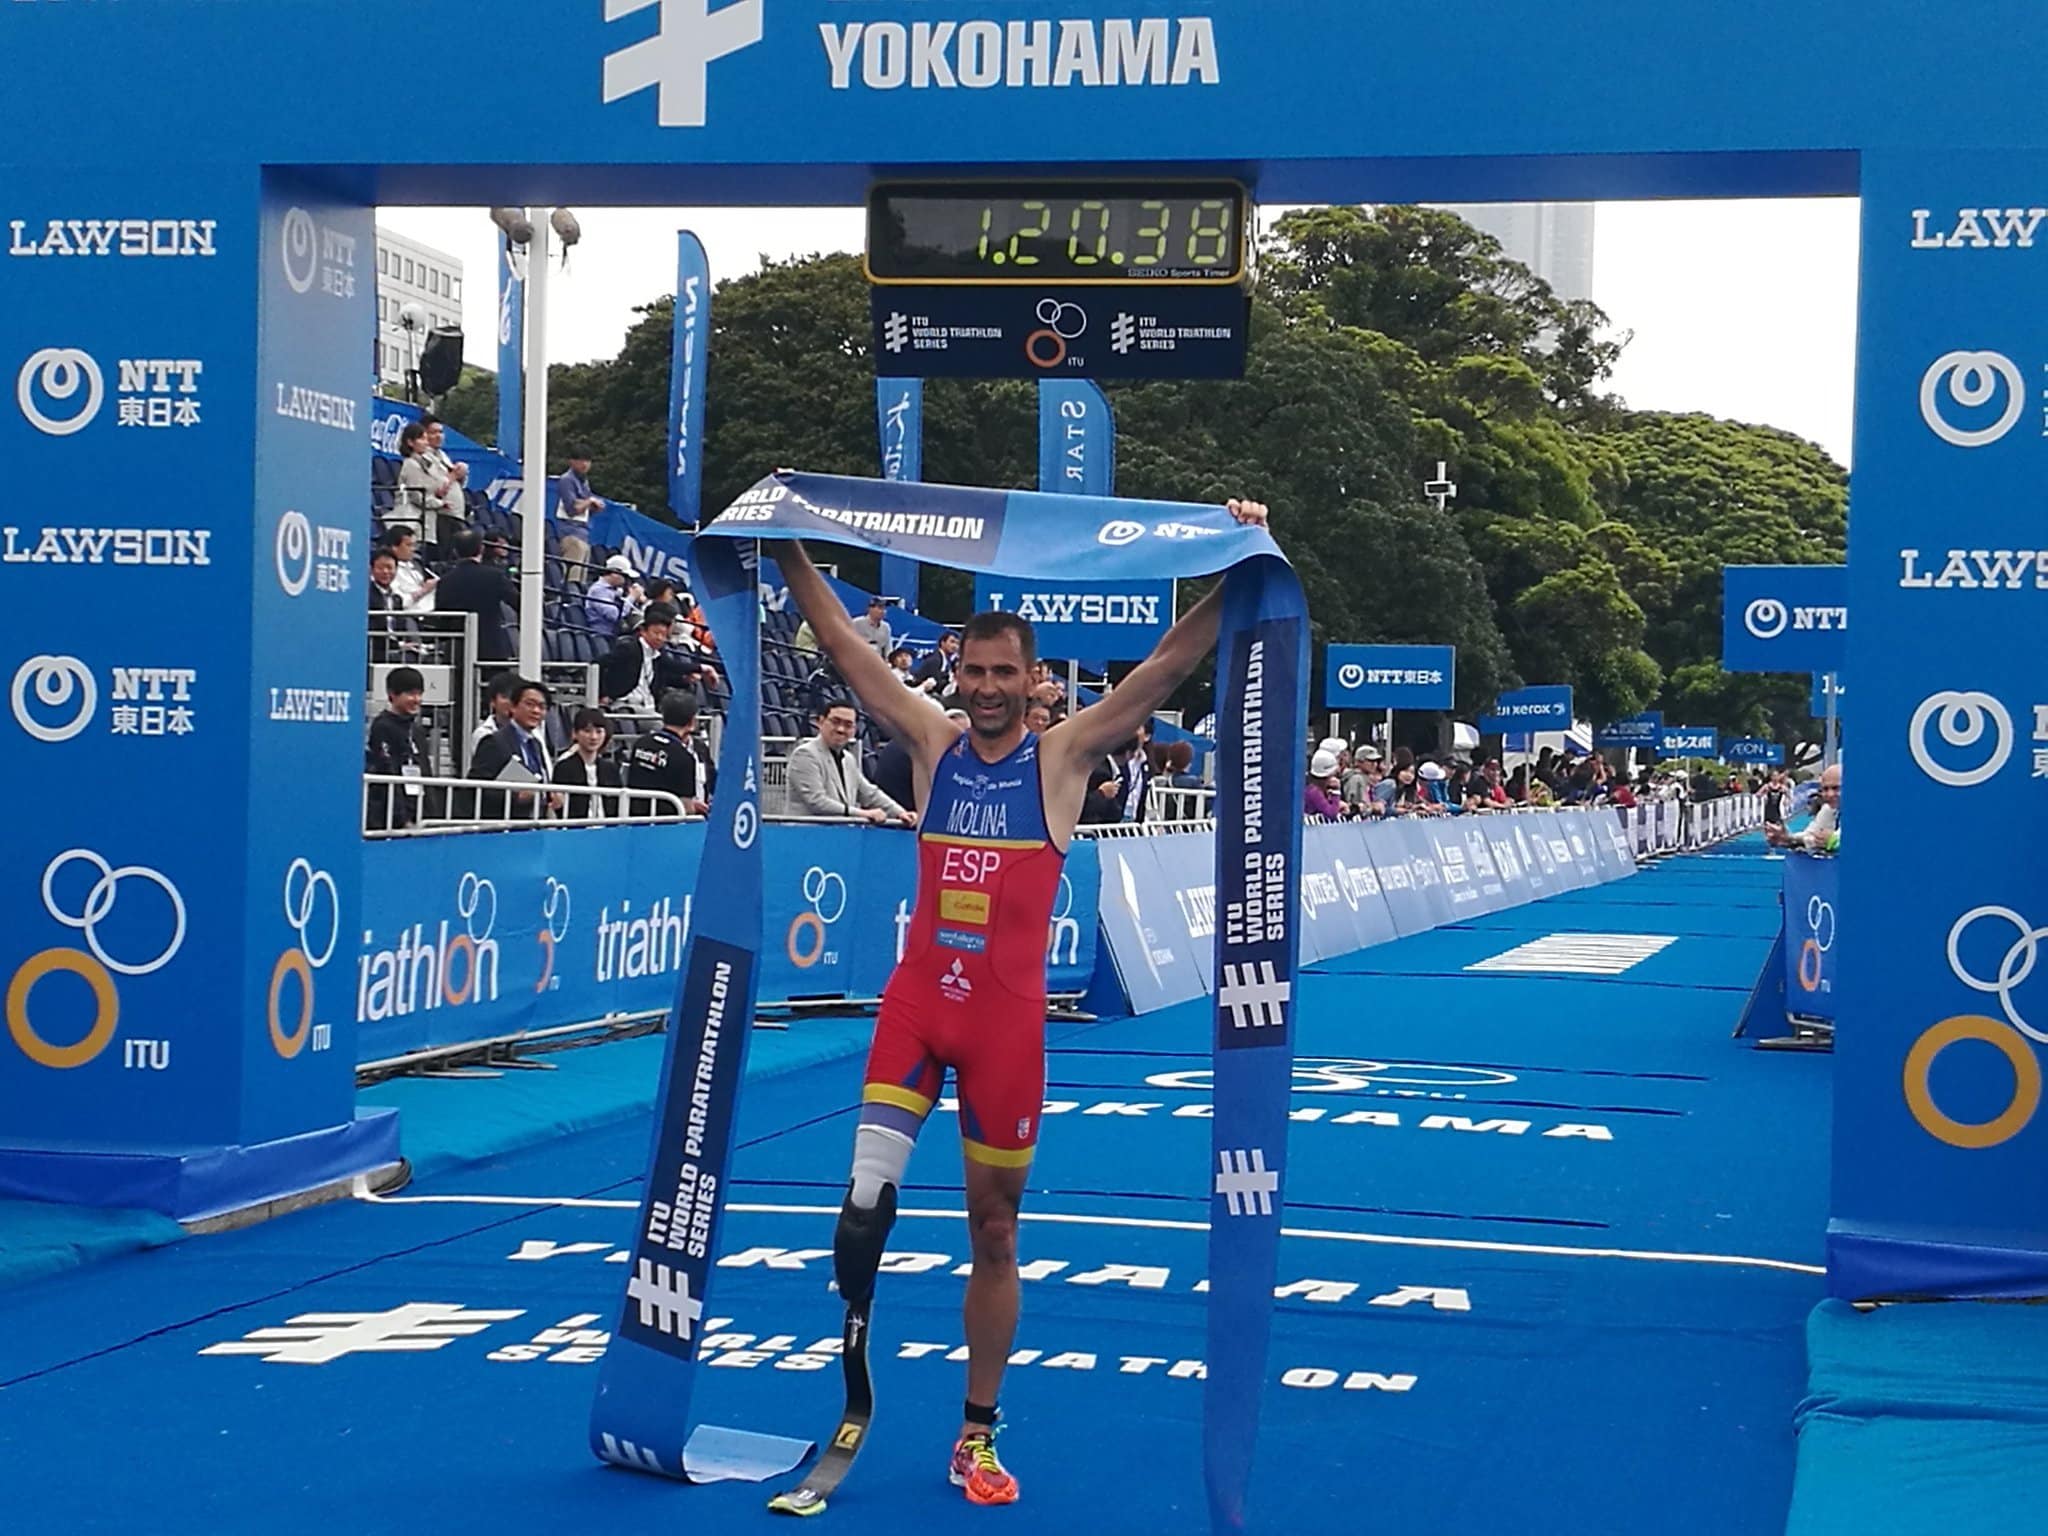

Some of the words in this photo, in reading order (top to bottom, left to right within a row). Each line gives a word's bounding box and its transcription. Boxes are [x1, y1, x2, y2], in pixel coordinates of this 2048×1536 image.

[819, 17, 1220, 89] YOKOHAMA
[9, 220, 217, 256] LAWSON
[322, 228, 356, 267] NTT
[976, 201, 1231, 265] 1.20.38
[321, 267, 356, 298] 東日本
[1127, 268, 1169, 278] SEIKO
[1170, 268, 1201, 279] Sports
[1204, 268, 1230, 278] Timer
[911, 316, 929, 327] ITU
[911, 327, 949, 338] WORLD
[950, 327, 1003, 338] TRIATHLON
[1138, 316, 1157, 327] ITU
[1139, 327, 1176, 339] WORLD
[1177, 327, 1232, 339] TRIATHLON
[913, 338, 949, 350] SERIES
[1139, 339, 1176, 350] SERIES
[117, 359, 203, 392] NTT
[1067, 356, 1085, 368] ITU
[117, 397, 202, 428] 東日本
[276, 382, 356, 432] LAWSON
[2, 527, 211, 566] LAWSON
[317, 526, 352, 561] NTT
[315, 563, 351, 593] 東日本
[990, 593, 1160, 625] LAWSON
[111, 668, 196, 701] NTT
[111, 705, 195, 736] 東日本
[269, 688, 350, 723] LAWSON
[1512, 703, 1551, 716] xerox
[1244, 641, 1264, 844] PARATRIATHLON
[1662, 735, 1713, 750] セレスポ
[946, 799, 1008, 837] MOLINA
[942, 848, 1001, 884] ESP
[1244, 851, 1262, 945] WORLD
[1265, 852, 1285, 942] SERIES
[1227, 902, 1244, 945] ITU
[357, 919, 500, 1023] iathlon
[822, 951, 839, 965] ITU
[312, 1023, 332, 1052] ITU
[124, 1039, 170, 1070] ITU
[667, 1162, 699, 1252] WORLD
[684, 961, 733, 1159] PARATRIATHLON
[648, 1199, 672, 1244] ITU
[688, 1173, 718, 1260] SERIES
